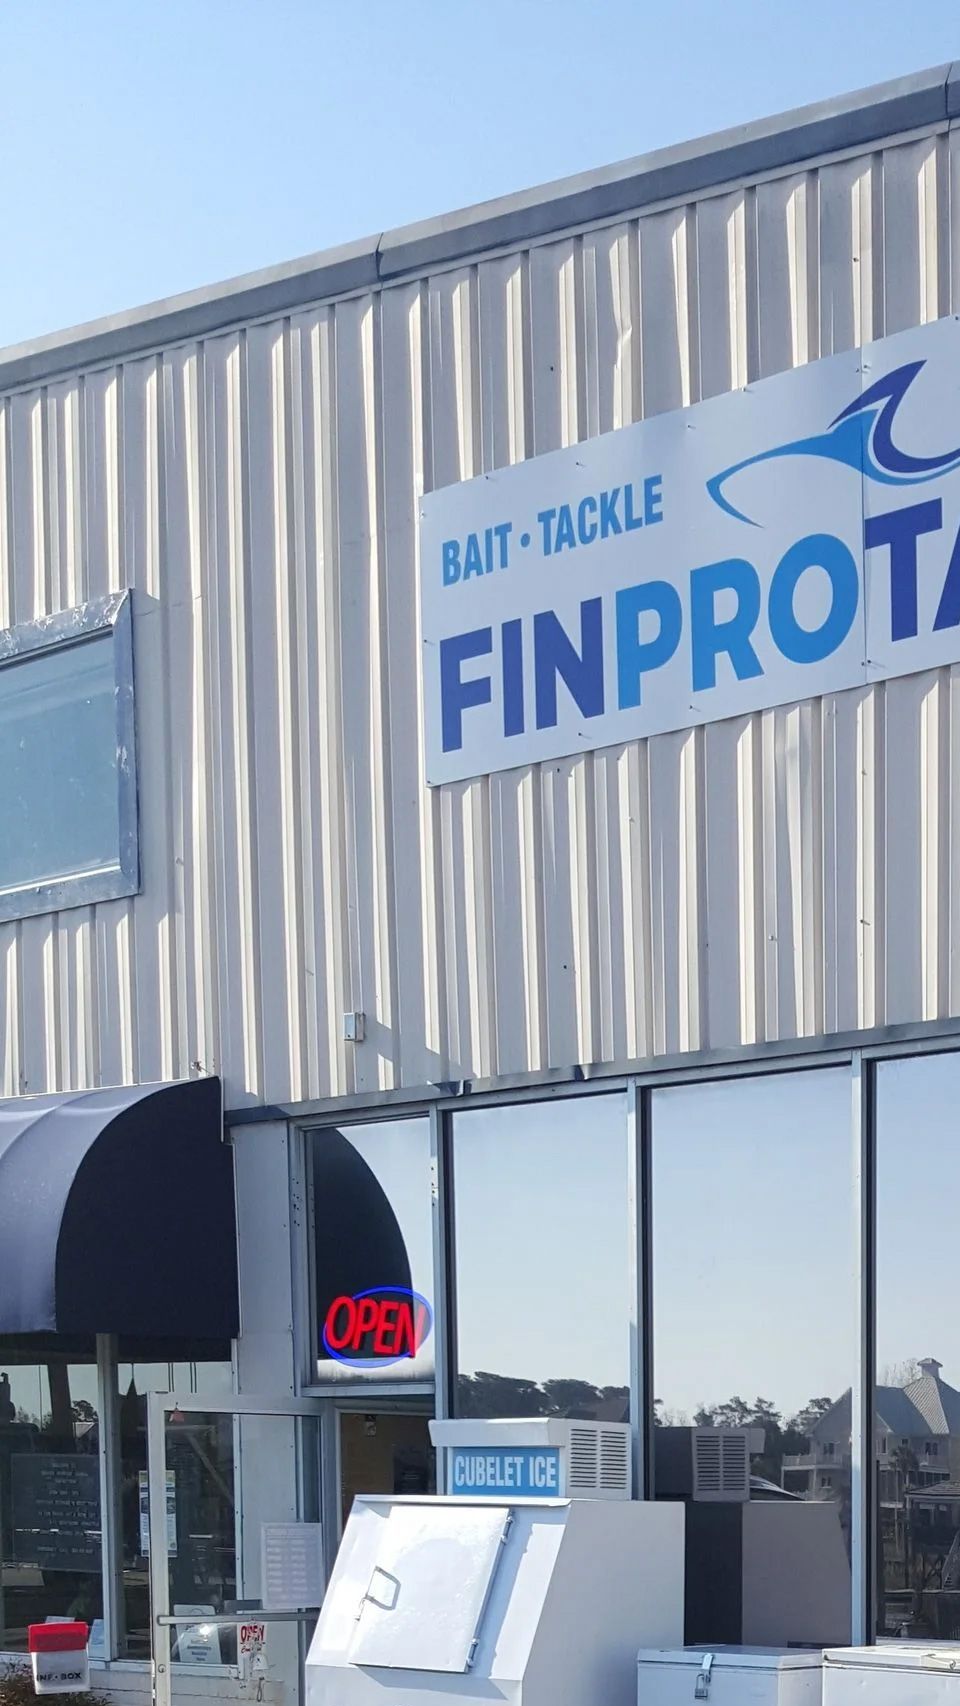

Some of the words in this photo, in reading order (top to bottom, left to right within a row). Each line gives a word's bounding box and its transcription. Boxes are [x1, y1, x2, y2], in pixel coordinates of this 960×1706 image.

[442, 521, 513, 587] BAIT
[537, 474, 664, 557] TACKLE
[325, 1296, 426, 1359] OPEN
[454, 1455, 524, 1488] CUBELET
[529, 1455, 557, 1488] ICE
